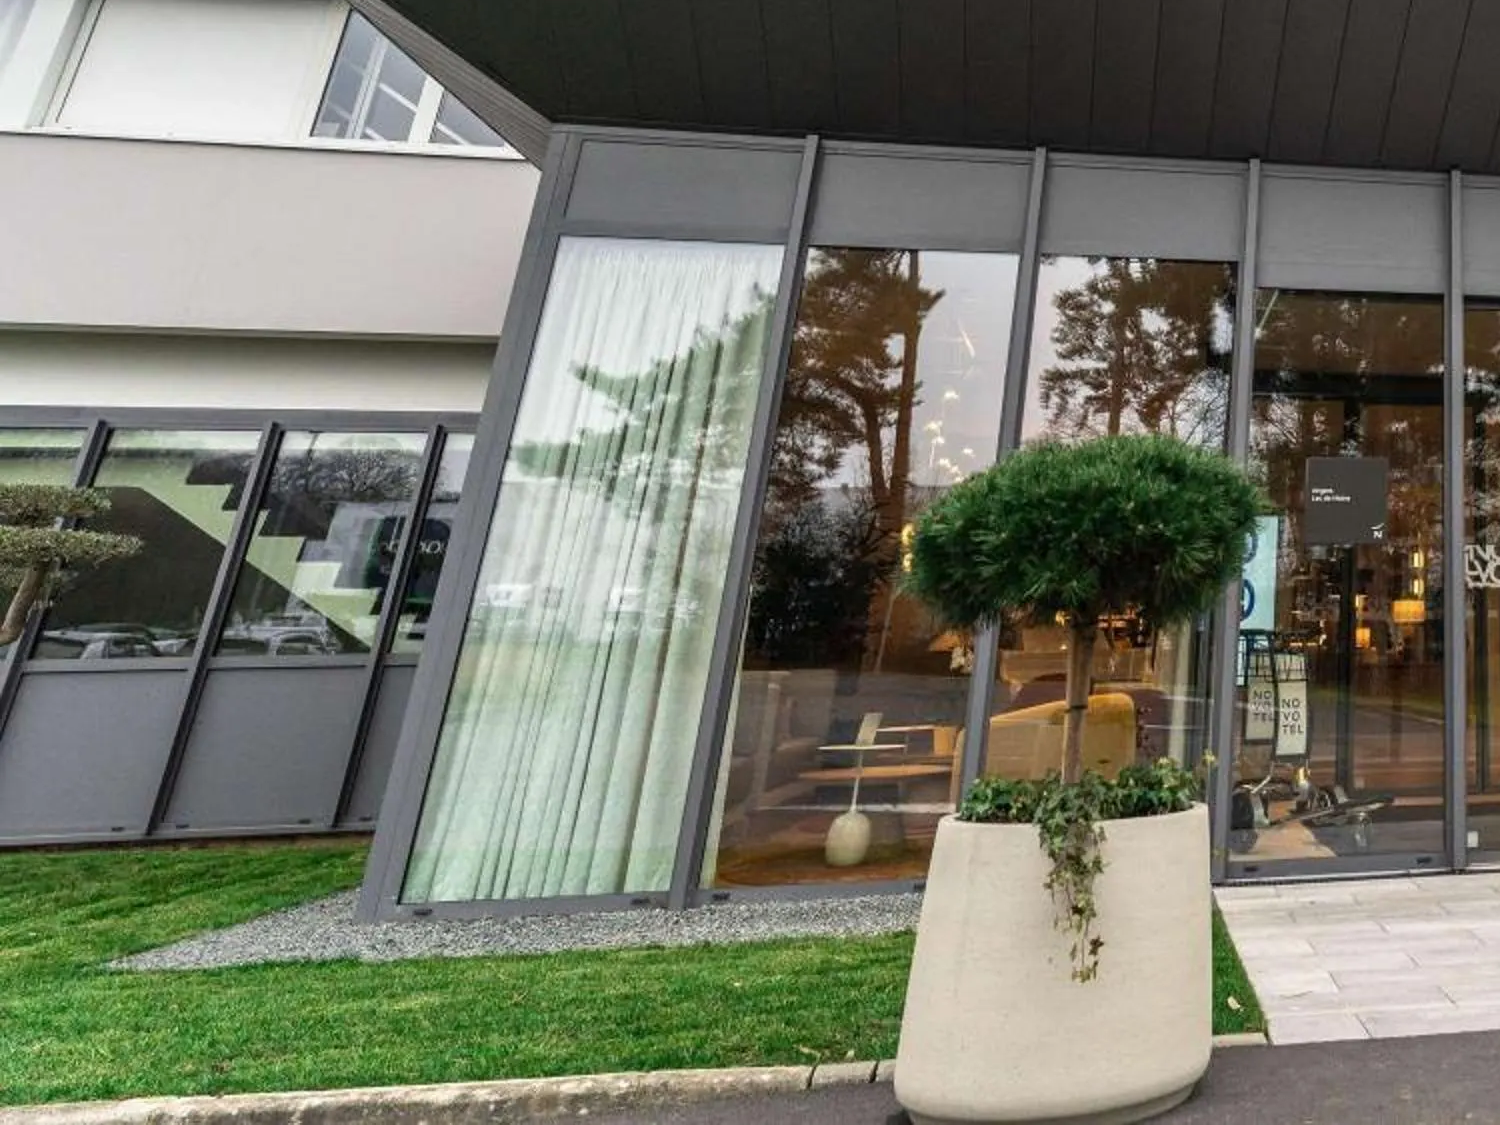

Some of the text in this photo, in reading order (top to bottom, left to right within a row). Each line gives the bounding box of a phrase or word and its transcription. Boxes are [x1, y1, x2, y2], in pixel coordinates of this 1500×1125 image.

[1281, 698, 1301, 709] NO
[1281, 711, 1301, 722] VO
[1282, 724, 1305, 734] TEL
